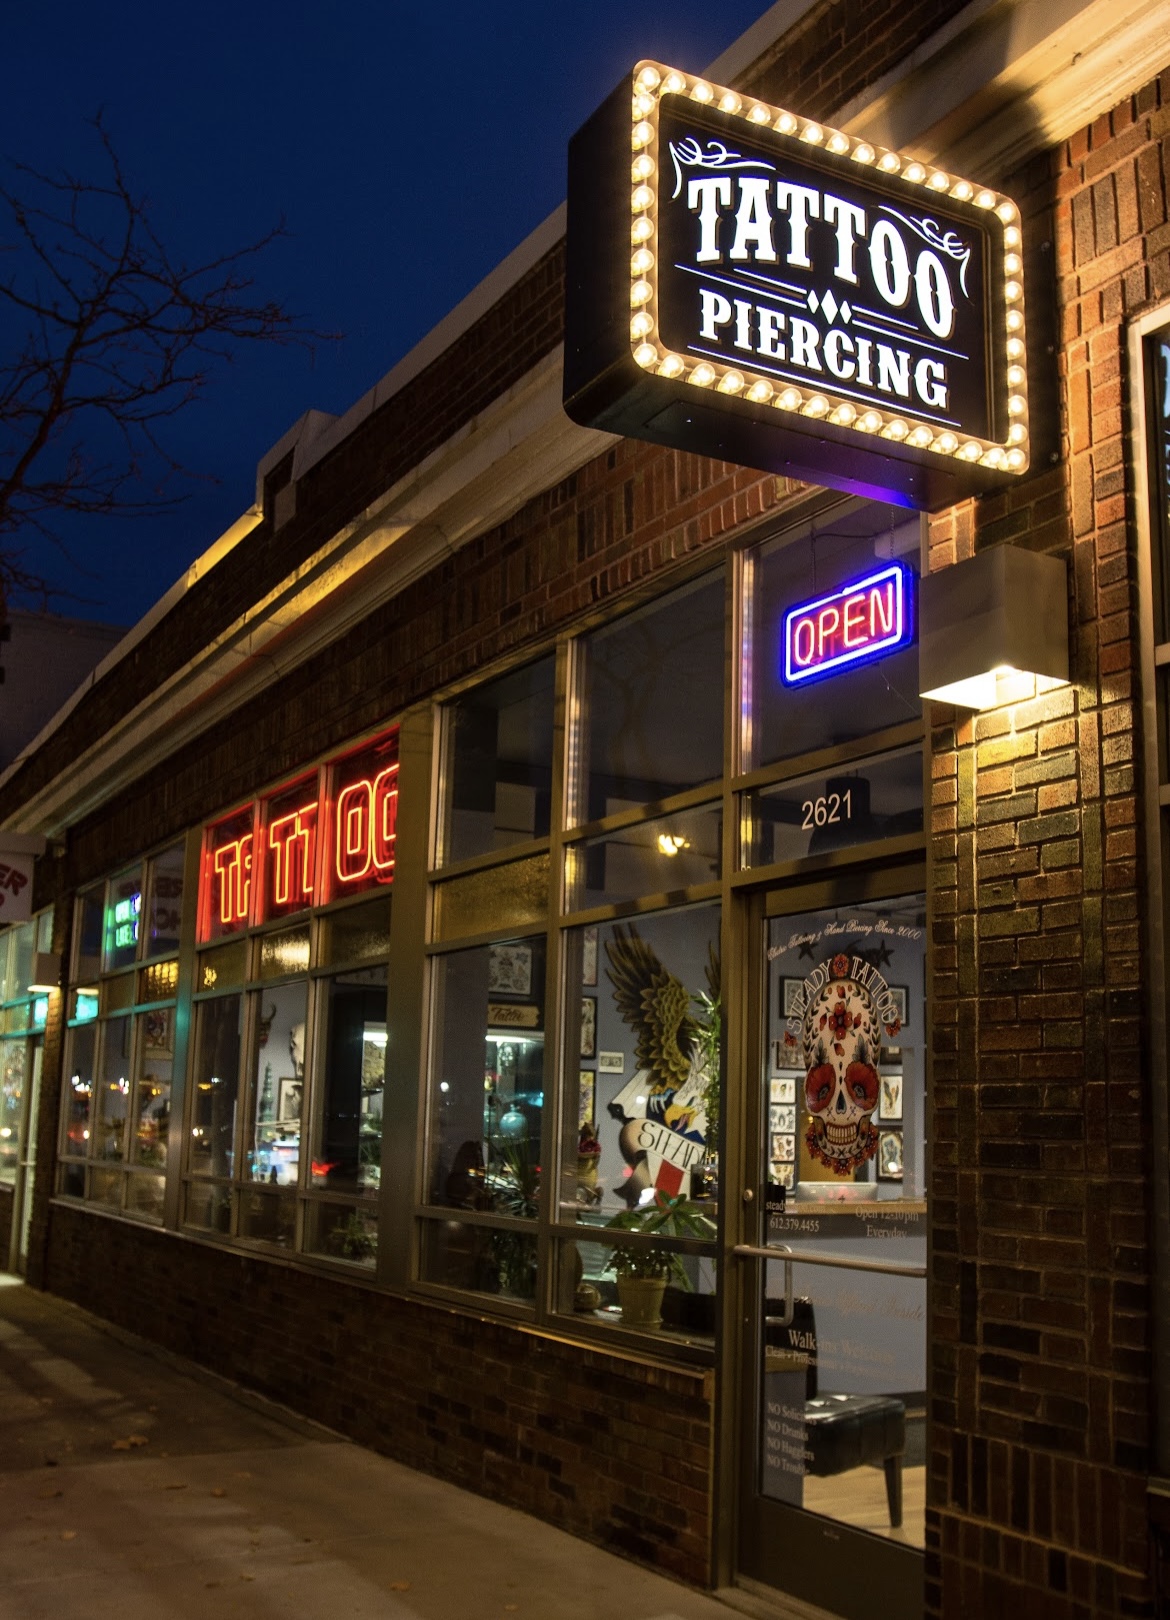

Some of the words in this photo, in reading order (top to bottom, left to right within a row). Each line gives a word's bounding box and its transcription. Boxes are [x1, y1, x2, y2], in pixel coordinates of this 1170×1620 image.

[687, 177, 954, 339] TATTOO
[699, 288, 949, 409] PIERCING
[794, 582, 893, 665] OPEN
[801, 789, 851, 831] 2621
[824, 921, 846, 936] Hand
[845, 918, 874, 937] Piercing
[875, 919, 895, 936] Since
[896, 925, 922, 941] 2000
[786, 958, 832, 1036] STEADY
[850, 955, 899, 1024] TATTOO
[855, 1205, 878, 1221] Open
[769, 1217, 820, 1233] 612.379.4455
[866, 1224, 908, 1240] Everyday
[768, 1401, 780, 1416] NO
[768, 1419, 780, 1433] NO
[768, 1436, 780, 1450] NO
[768, 1453, 780, 1468] NO
